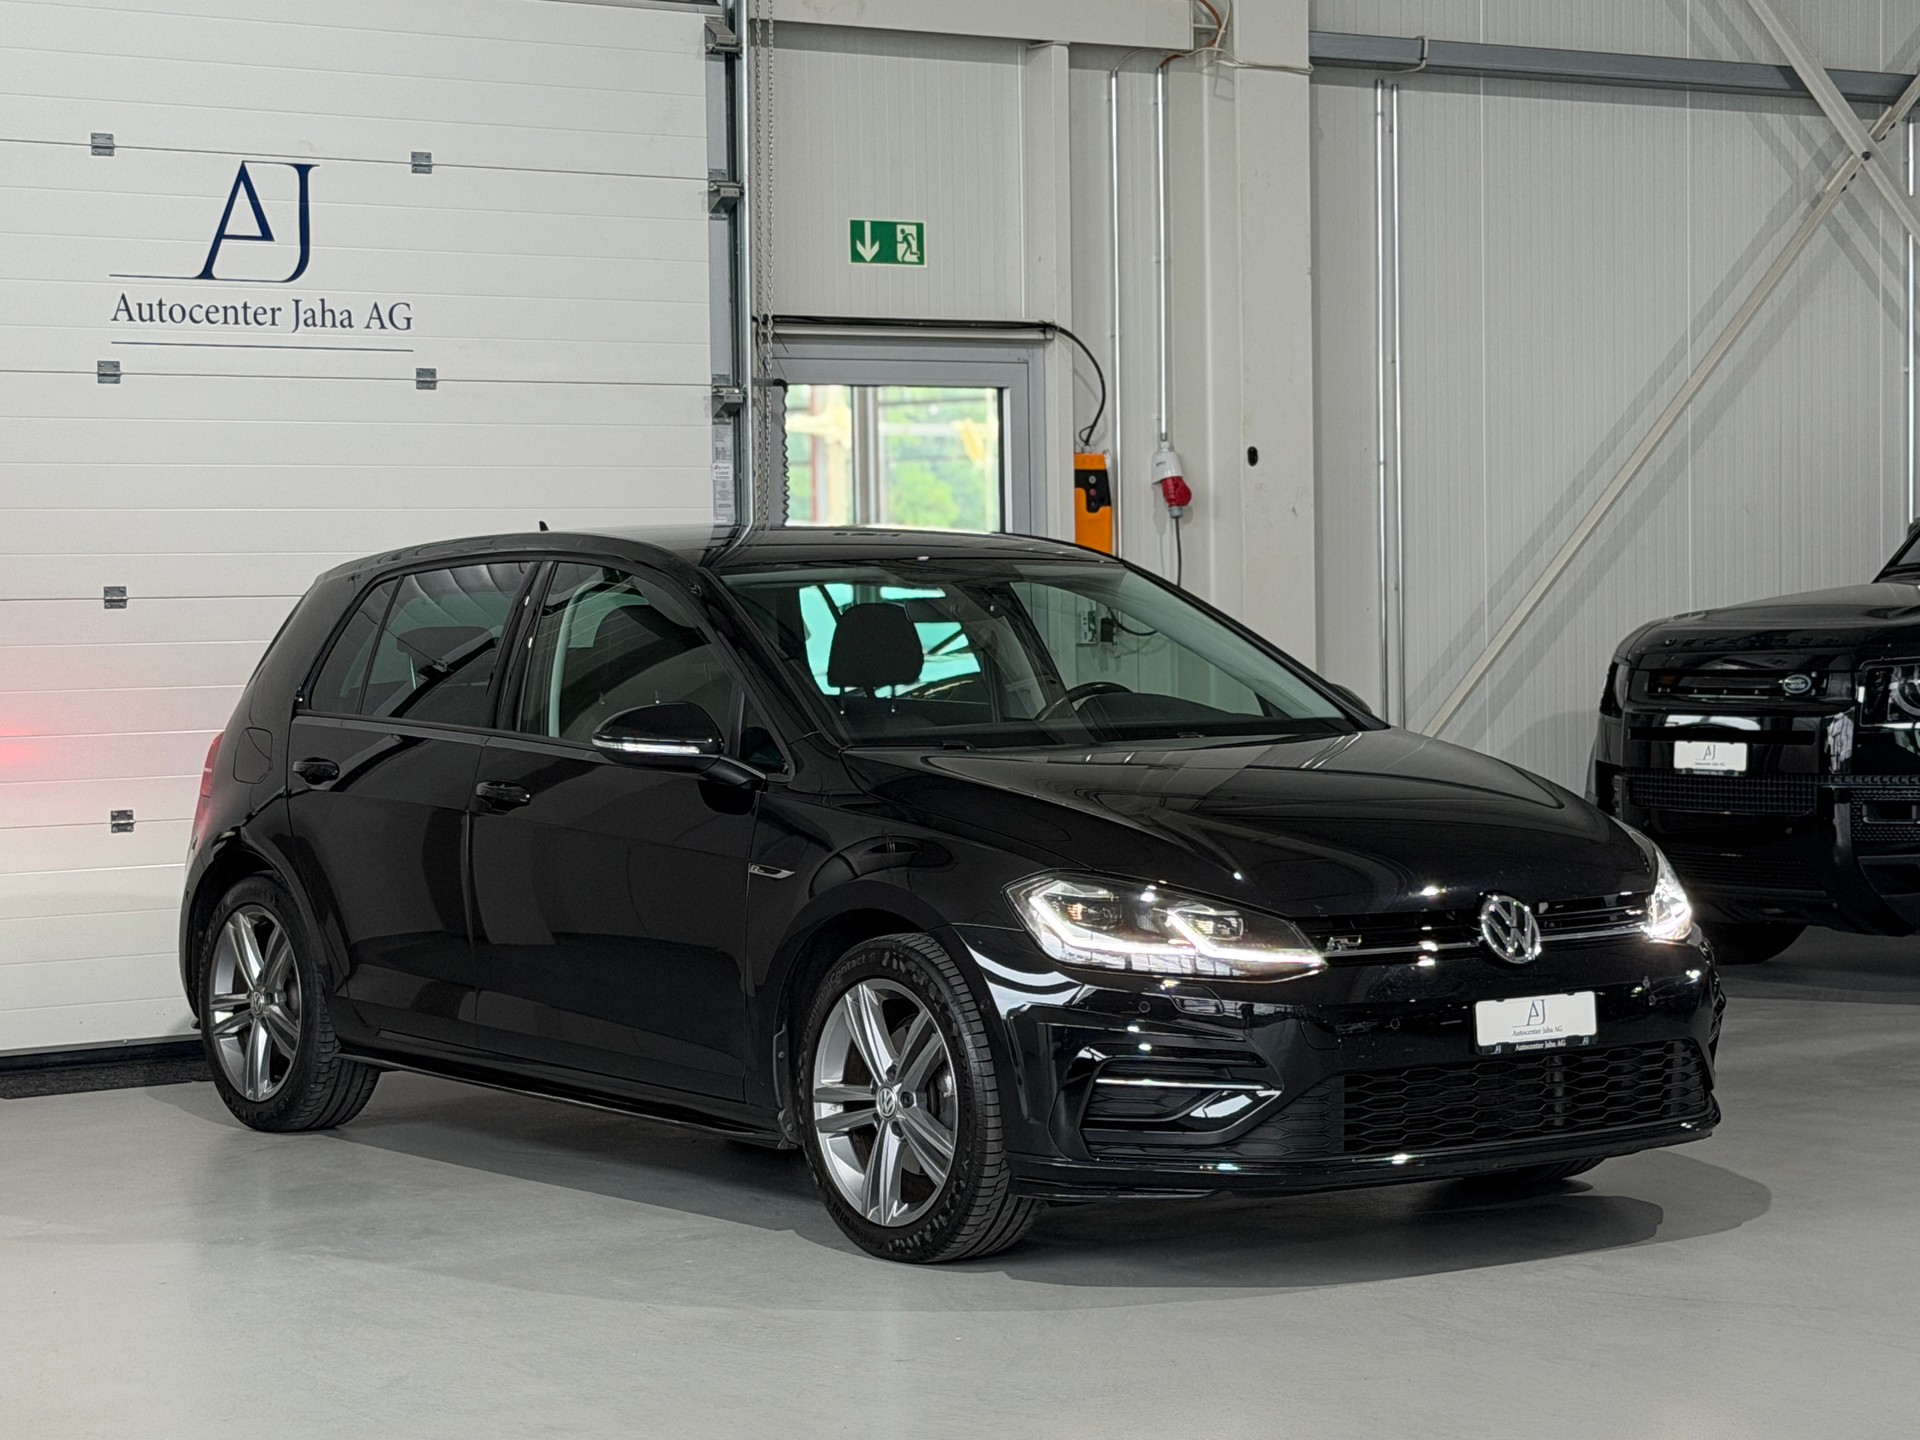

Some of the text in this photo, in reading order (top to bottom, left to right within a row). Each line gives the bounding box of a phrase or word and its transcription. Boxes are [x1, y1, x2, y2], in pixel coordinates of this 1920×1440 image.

[195, 160, 320, 283] AJ
[110, 293, 413, 334] Autocenter Jaha AG
[1512, 1025, 1563, 1037] Autocenter Jaha AG
[1515, 1042, 1544, 1051] Autocenter
[1545, 1040, 1556, 1049] Jaha
[1557, 1039, 1566, 1047] AG
